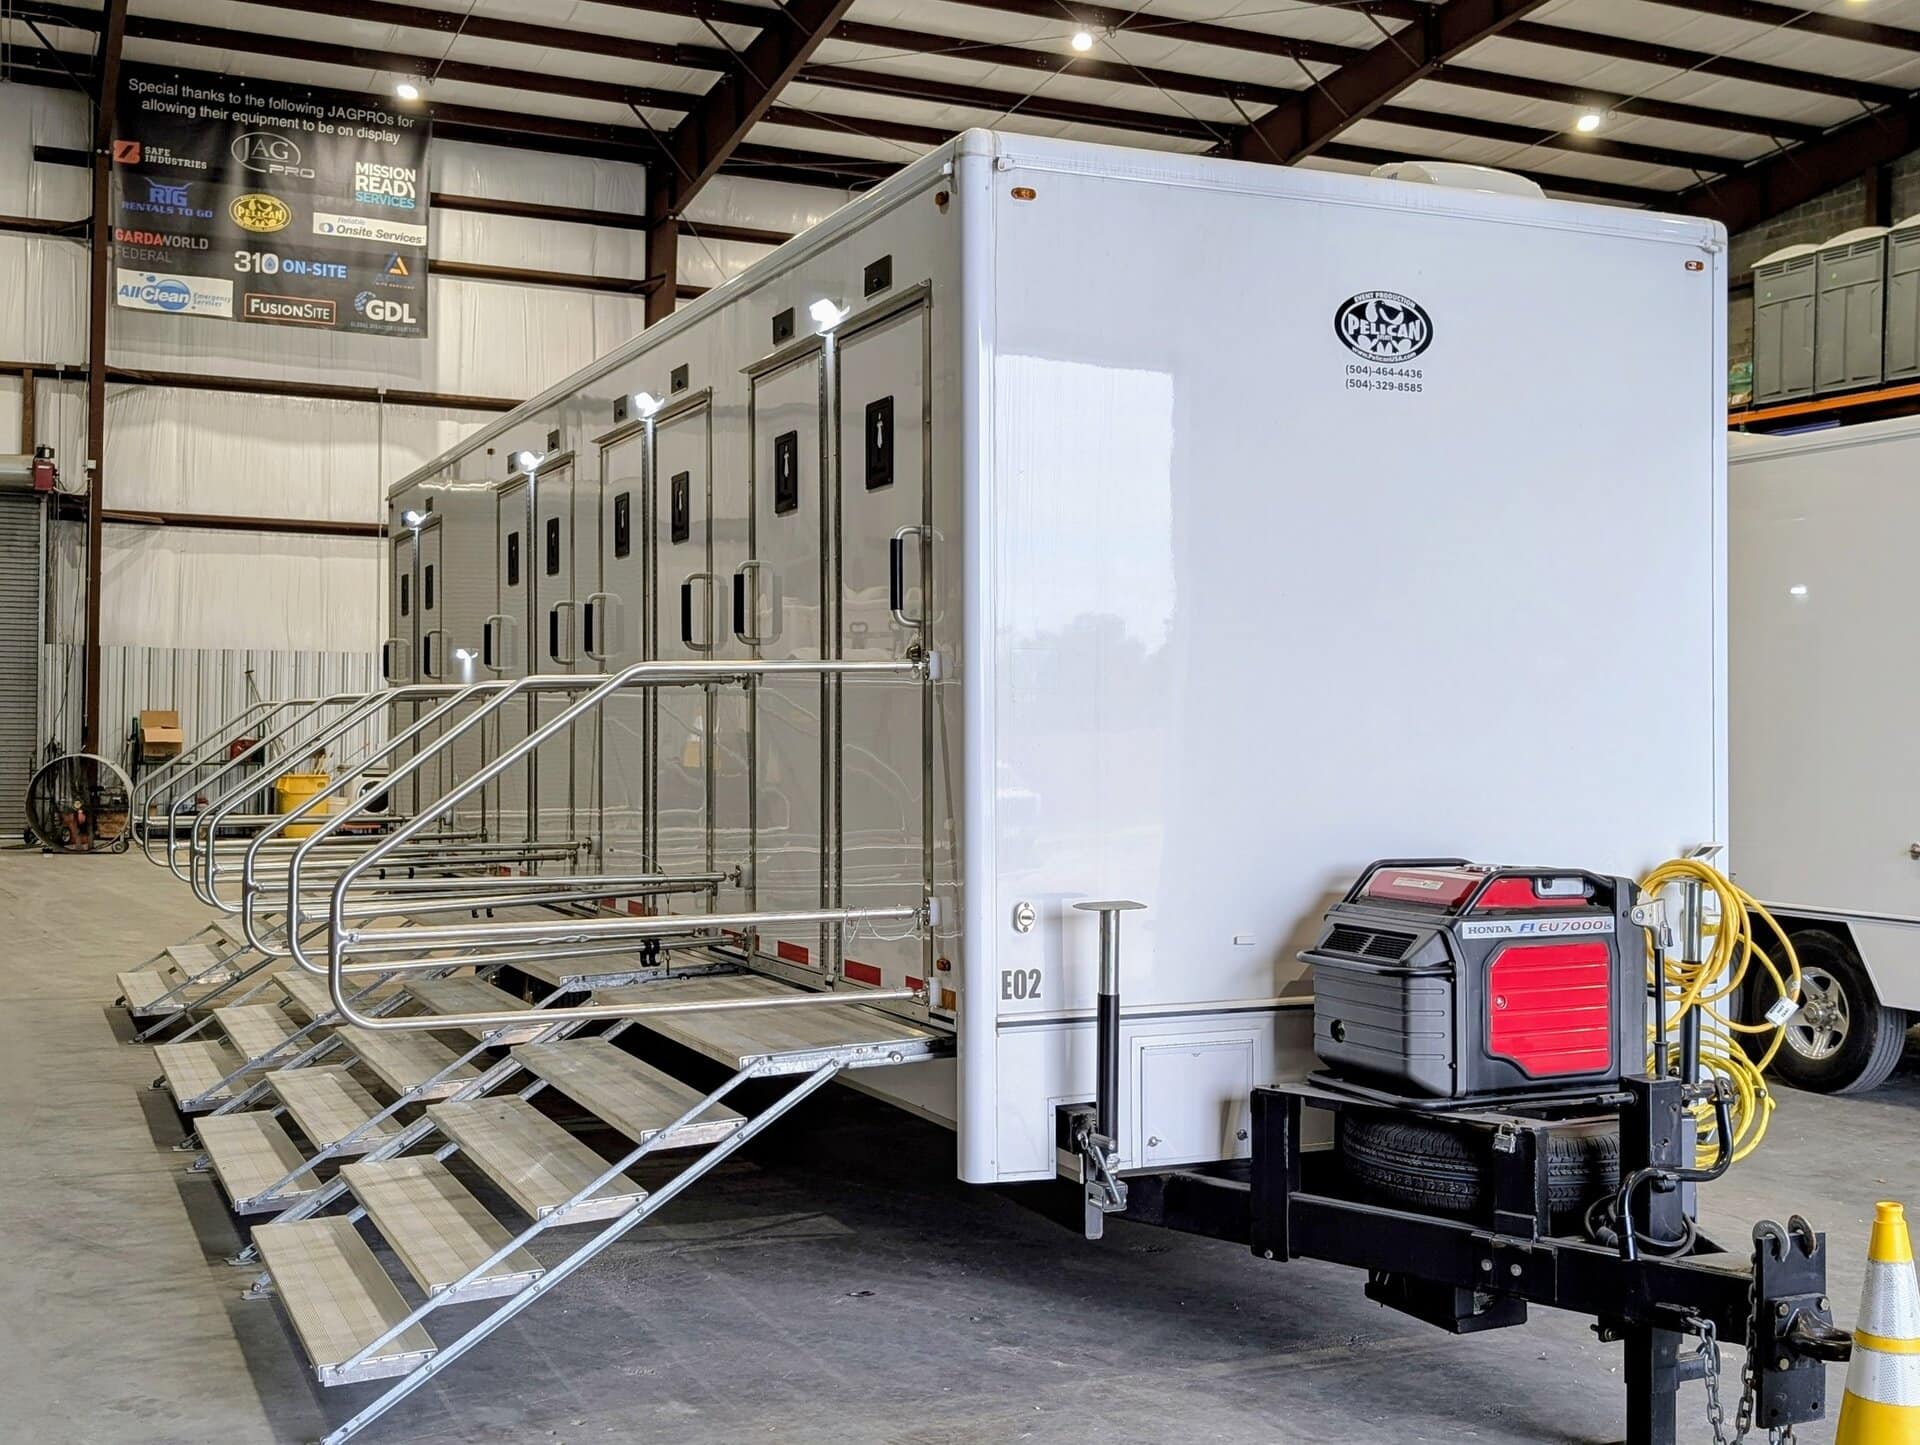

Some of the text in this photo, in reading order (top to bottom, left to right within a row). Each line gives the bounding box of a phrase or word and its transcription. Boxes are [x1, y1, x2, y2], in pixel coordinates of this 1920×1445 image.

[128, 78, 415, 128] Special thanks to the following JAGPROs for
[141, 98, 401, 145] allowing their equipment to be on display
[144, 146, 171, 157] SAFE
[240, 137, 289, 162] JAG
[144, 154, 208, 169] INDUSTRIES
[269, 164, 316, 179] PRO
[355, 161, 416, 183] MISSION
[121, 201, 214, 218] RENTALS TO GO
[355, 191, 416, 209] SERVICES
[237, 205, 283, 221] PELICAN
[115, 228, 209, 250] GARDAWORLD
[336, 224, 423, 245] Onsite Services
[116, 245, 173, 263] FEDERAL
[233, 250, 348, 279] 310 ON-SITE
[119, 284, 190, 304] AllClean
[365, 299, 417, 324] GDL
[1347, 313, 1421, 342] PELICAN
[1345, 364, 1423, 380] (504)-464-4436
[1345, 378, 1423, 393] (504)-329-8585
[1468, 925, 1513, 935] HONDA
